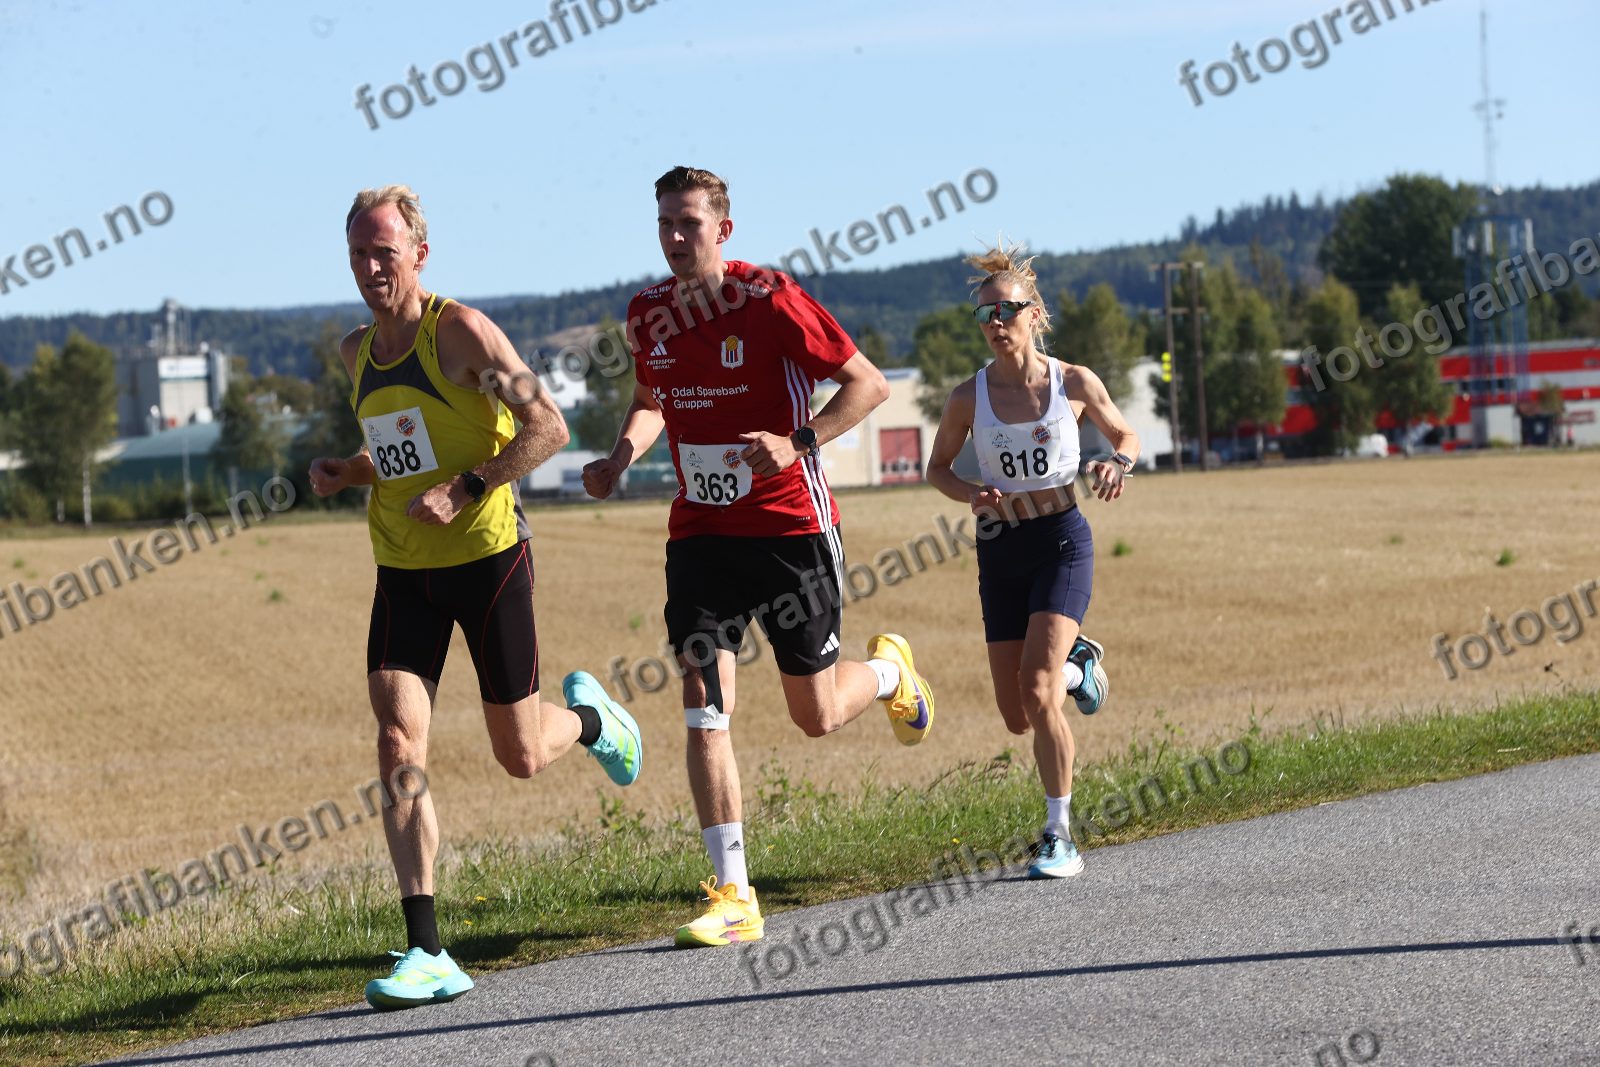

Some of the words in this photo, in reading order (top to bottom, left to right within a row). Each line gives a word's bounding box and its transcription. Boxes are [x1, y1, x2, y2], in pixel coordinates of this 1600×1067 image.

[671, 386, 695, 398] Odal
[696, 384, 749, 397] Sparebank
[673, 399, 714, 410] Gruppen
[376, 440, 421, 477] 838
[1000, 447, 1049, 478] 818
[693, 472, 739, 502] 363
